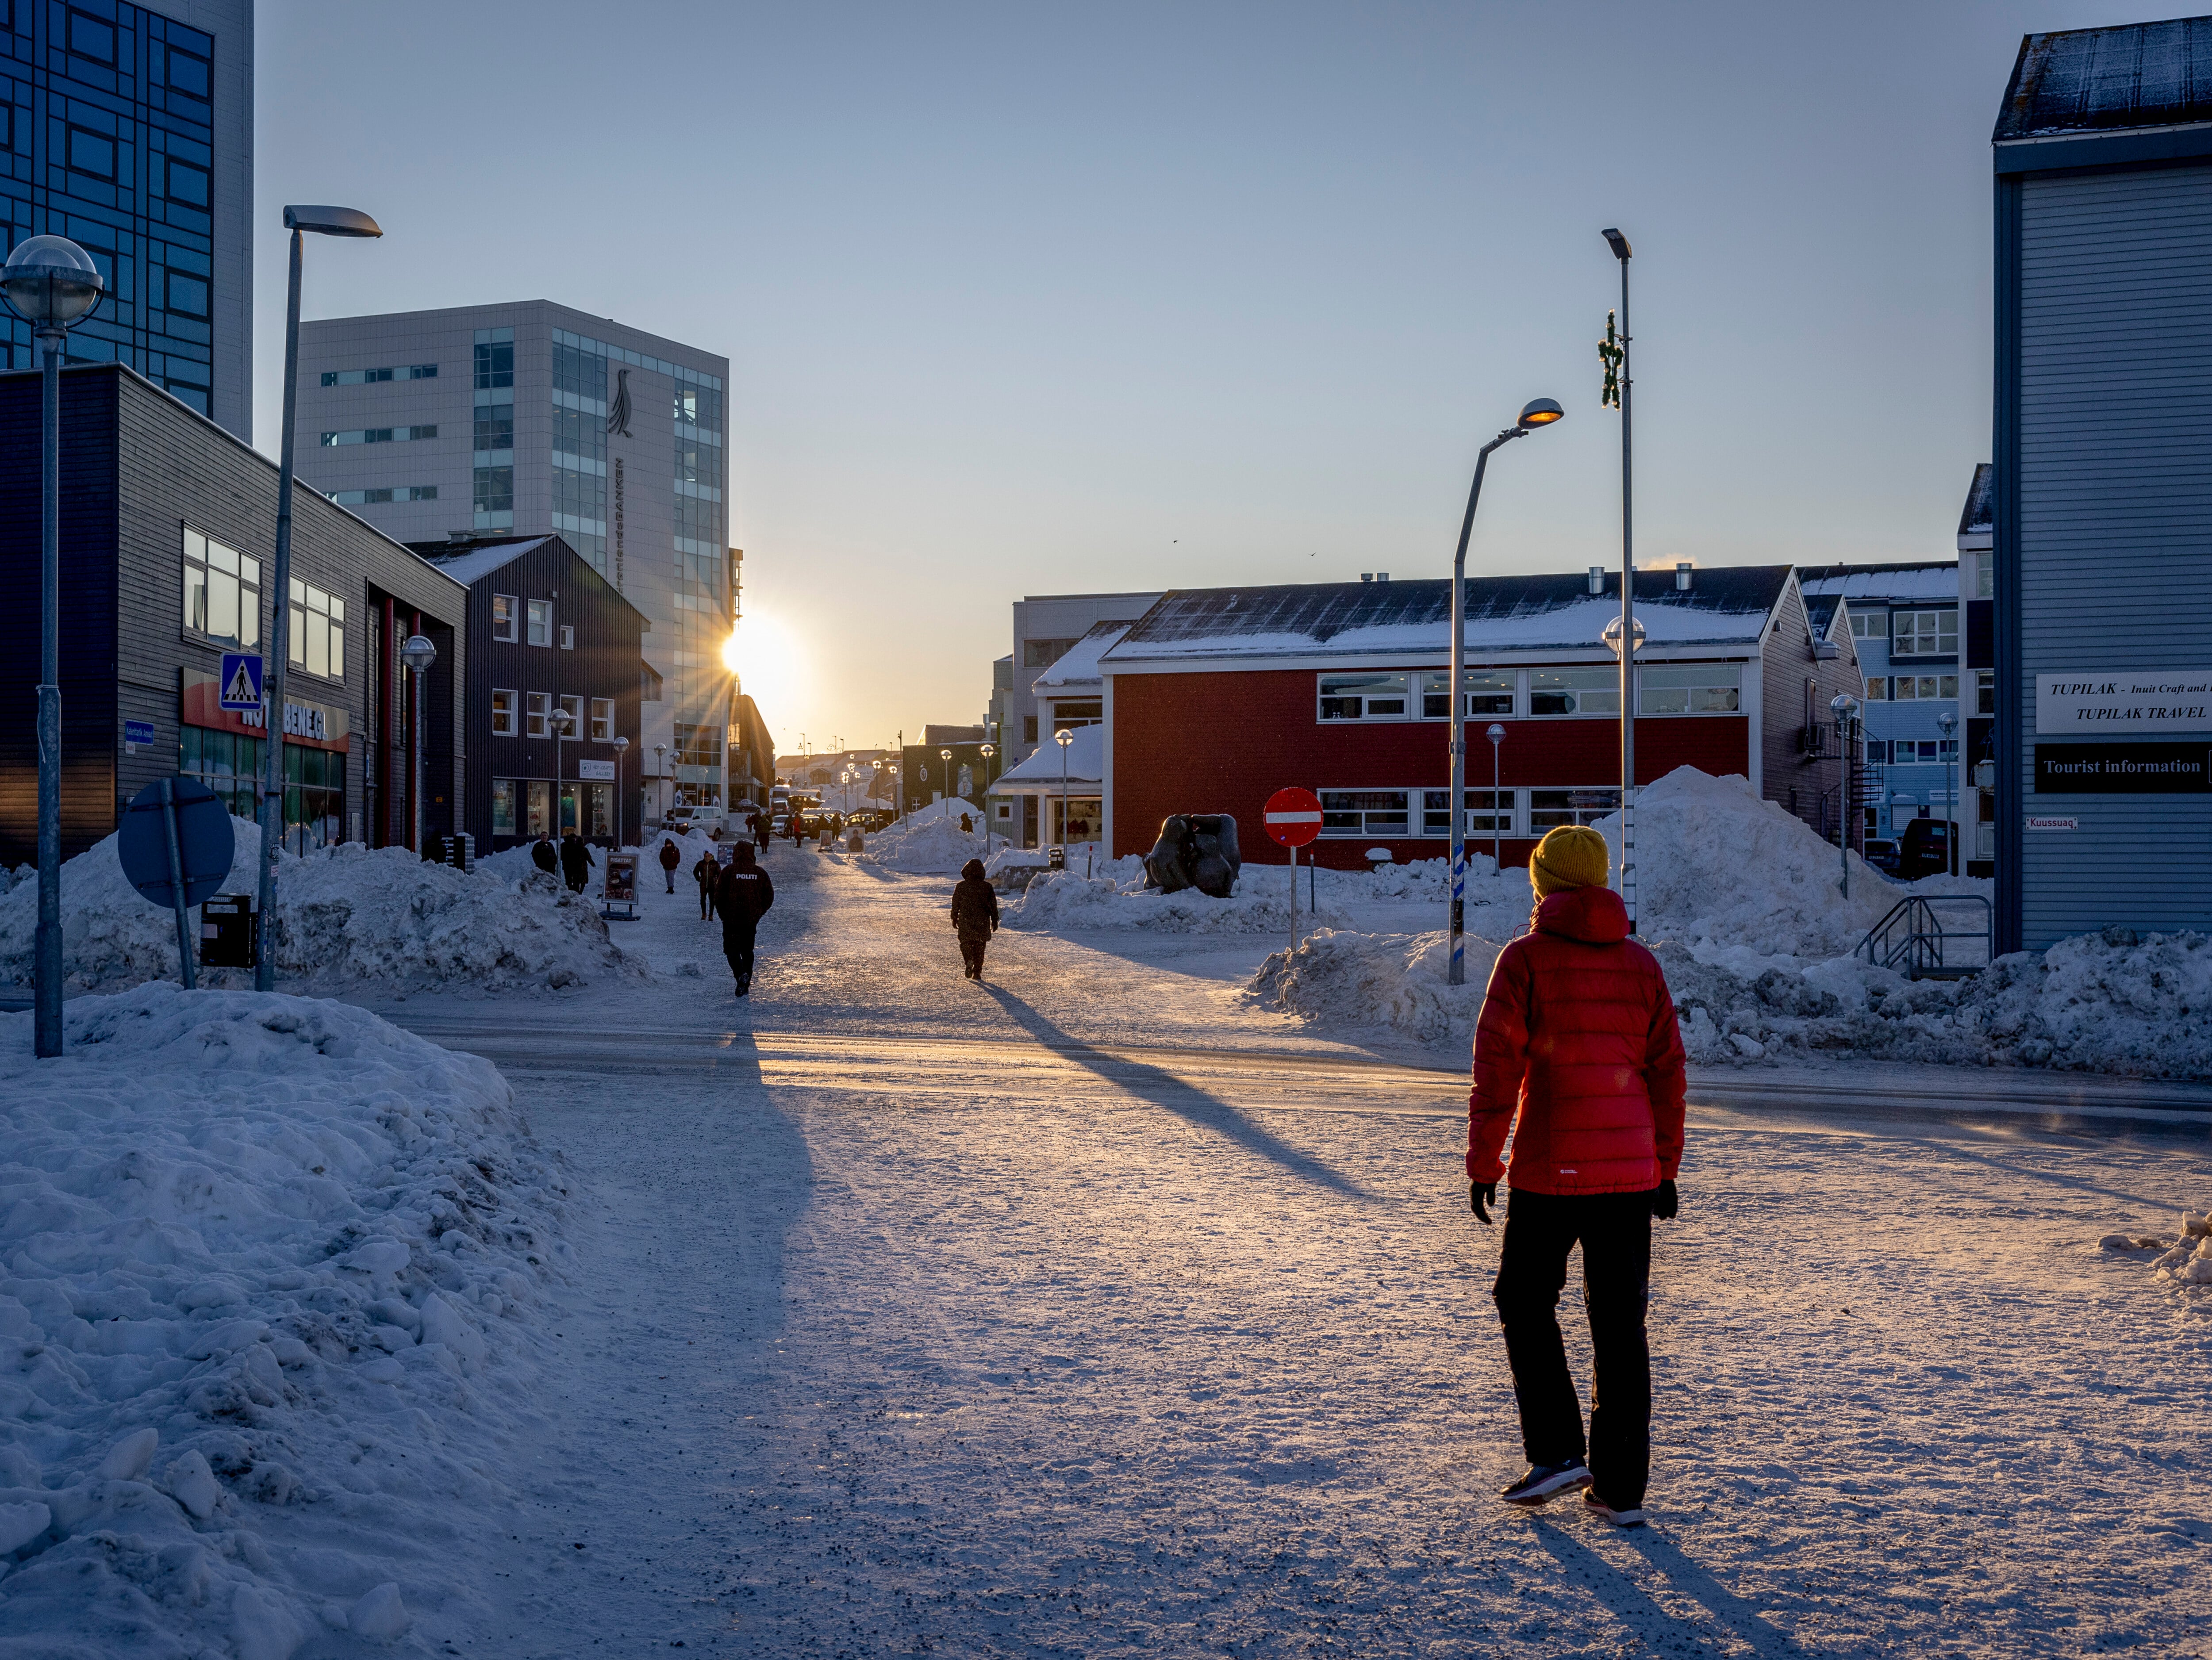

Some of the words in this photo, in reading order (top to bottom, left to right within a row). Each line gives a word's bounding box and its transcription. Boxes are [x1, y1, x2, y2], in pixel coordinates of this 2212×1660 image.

[2051, 683, 2117, 695] TUPILAK
[2131, 685, 2156, 693] Inuit
[2159, 684, 2184, 695] Craft
[2187, 684, 2207, 692] and
[2077, 708, 2143, 720] TUPILAK
[2147, 707, 2207, 719] TRAVEL
[2044, 760, 2100, 773] Tourist
[2105, 759, 2200, 773] information
[2030, 818, 2073, 828] Kuussuaq
